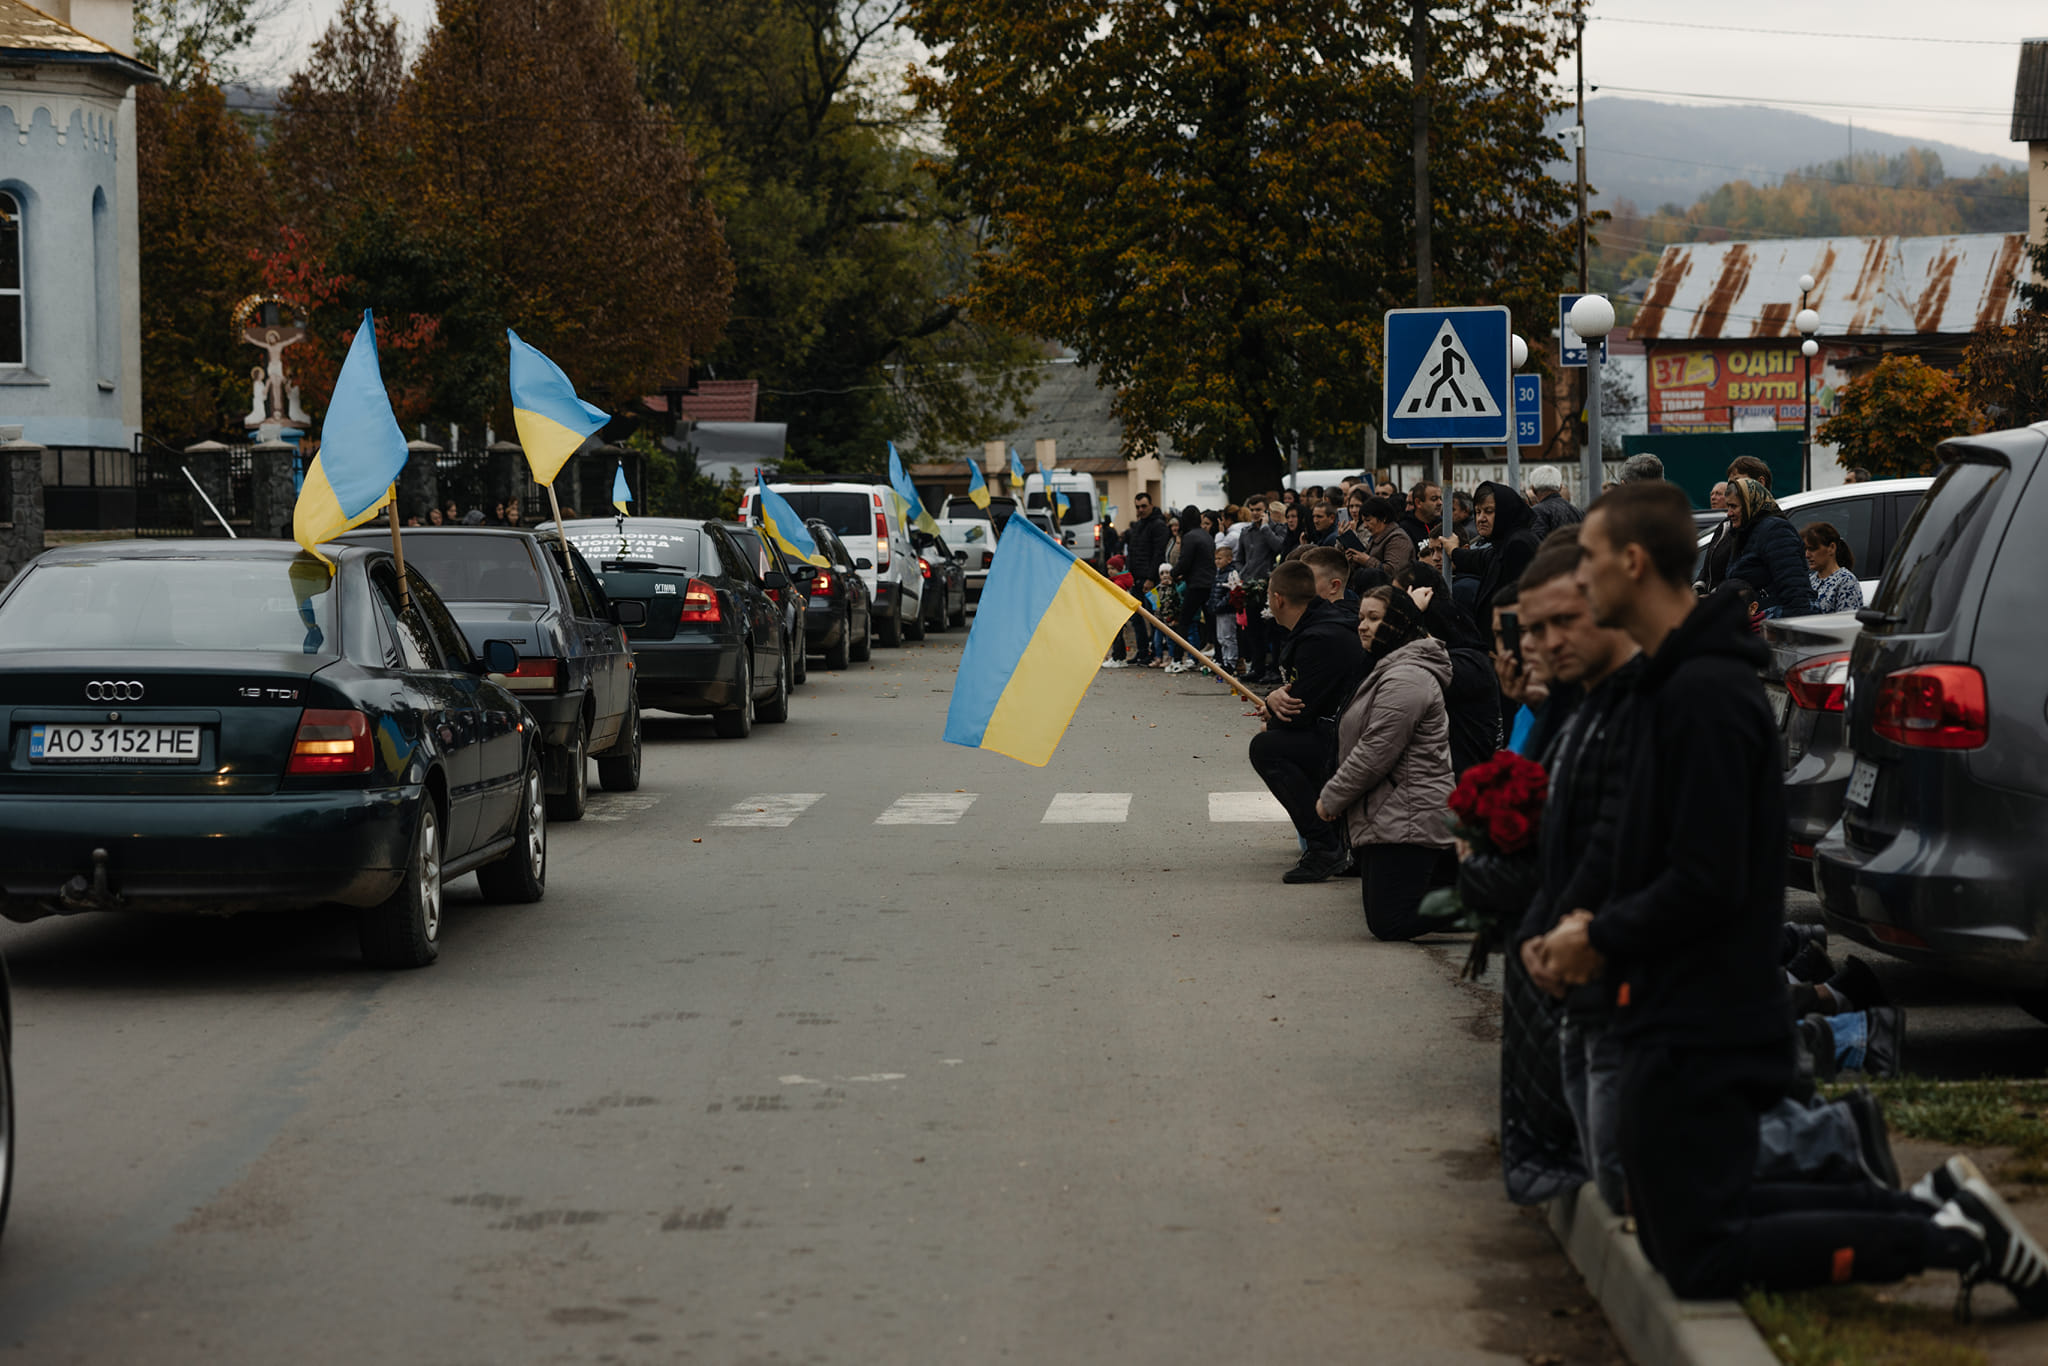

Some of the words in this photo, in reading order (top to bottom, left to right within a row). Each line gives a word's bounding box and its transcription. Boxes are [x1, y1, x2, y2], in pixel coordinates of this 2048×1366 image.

[1655, 356, 1688, 385] 37
[1727, 351, 1800, 376] ОДЯГ
[1519, 387, 1535, 401] 30
[1727, 381, 1798, 400] ВЗУТТЯ
[1519, 421, 1535, 436] 35
[266, 688, 299, 699] TDI
[32, 744, 44, 753] UA
[47, 729, 84, 753] AO
[90, 729, 151, 753] 3152
[156, 729, 195, 753] HE
